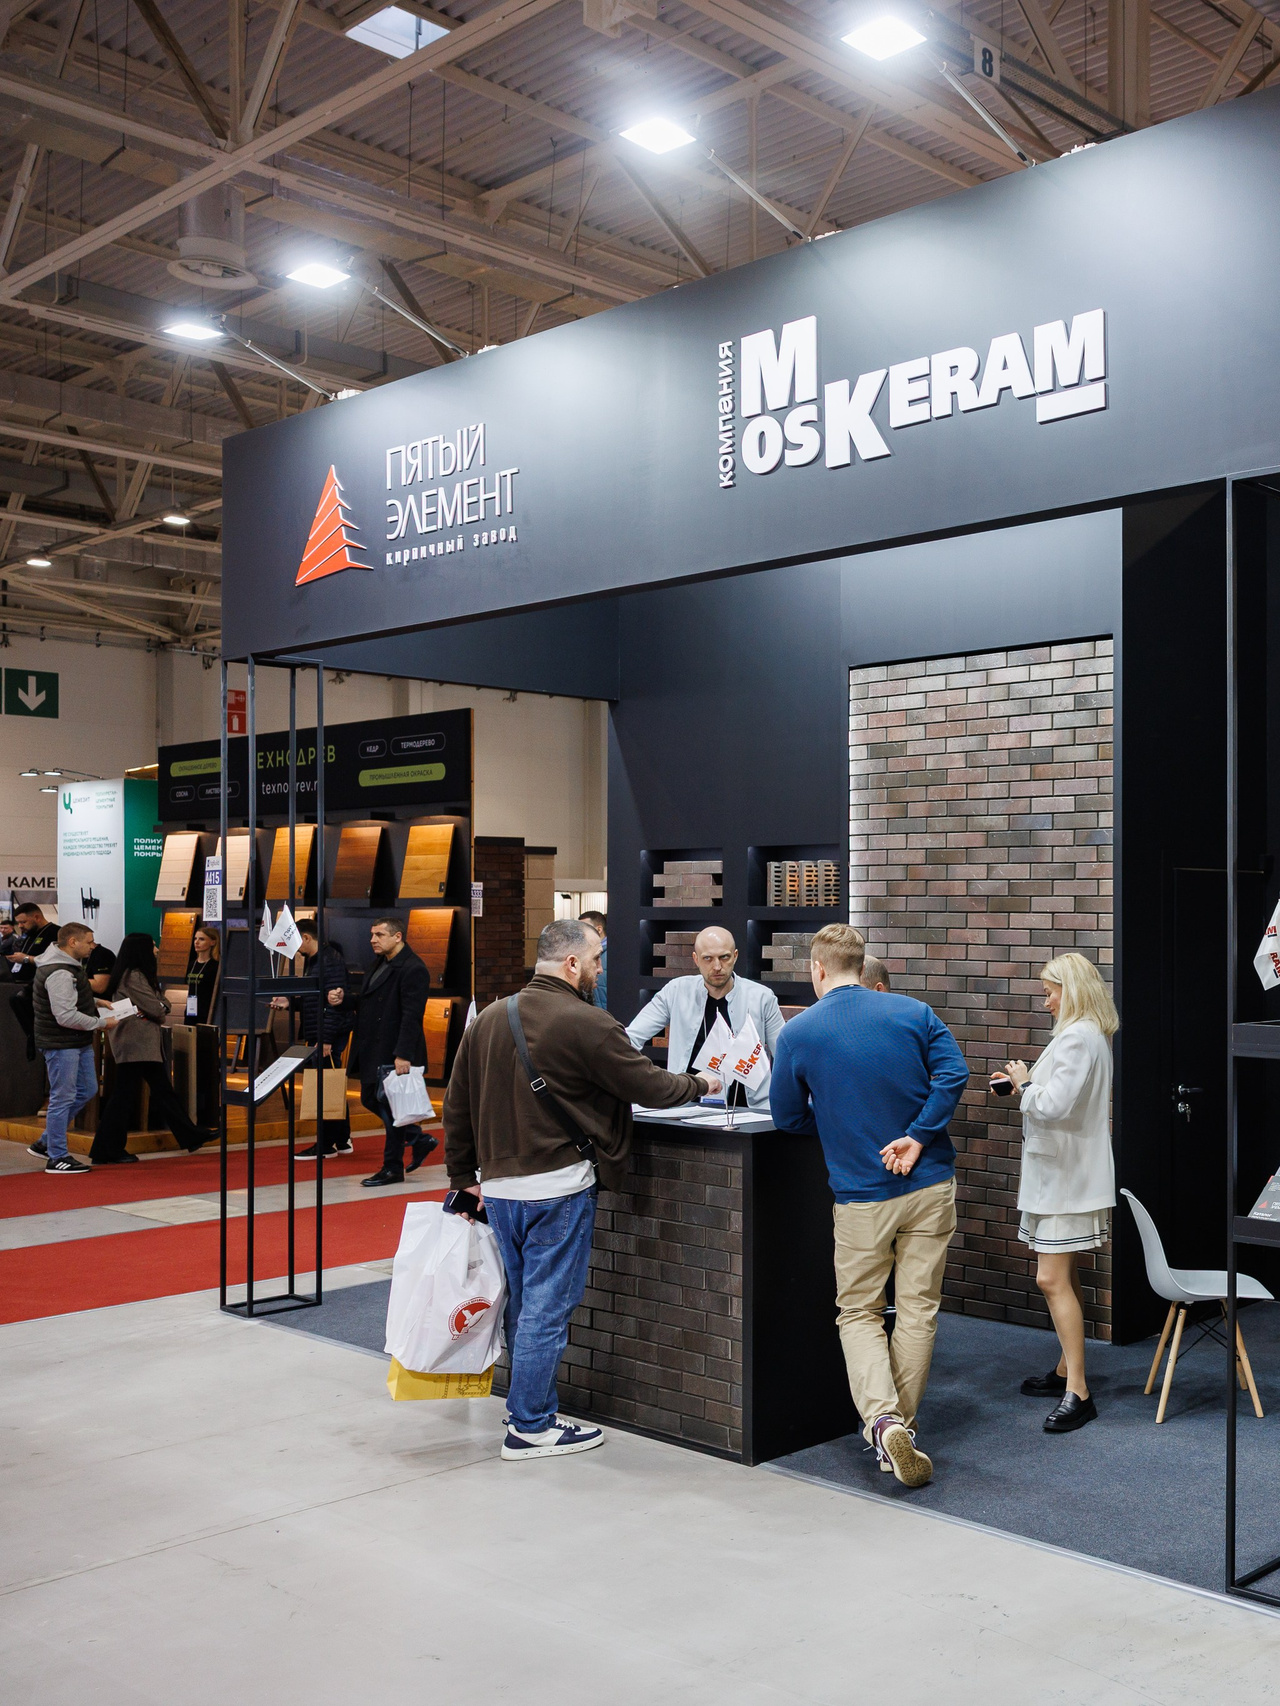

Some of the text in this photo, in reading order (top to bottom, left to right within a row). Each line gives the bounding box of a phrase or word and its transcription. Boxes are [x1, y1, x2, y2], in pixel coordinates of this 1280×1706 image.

[982, 47, 993, 77] 8
[386, 422, 486, 490] ПЯТЫЙ
[386, 467, 520, 540] ЭЛЕМЕНТ
[386, 525, 518, 567] кирпичный завод
[366, 745, 379, 753] КЕДР
[401, 739, 436, 749] ТЕРМОДЕРЕВО
[262, 780, 318, 795] texnorev.r
[7, 876, 58, 888] КАМЕ
[205, 871, 220, 885] A415
